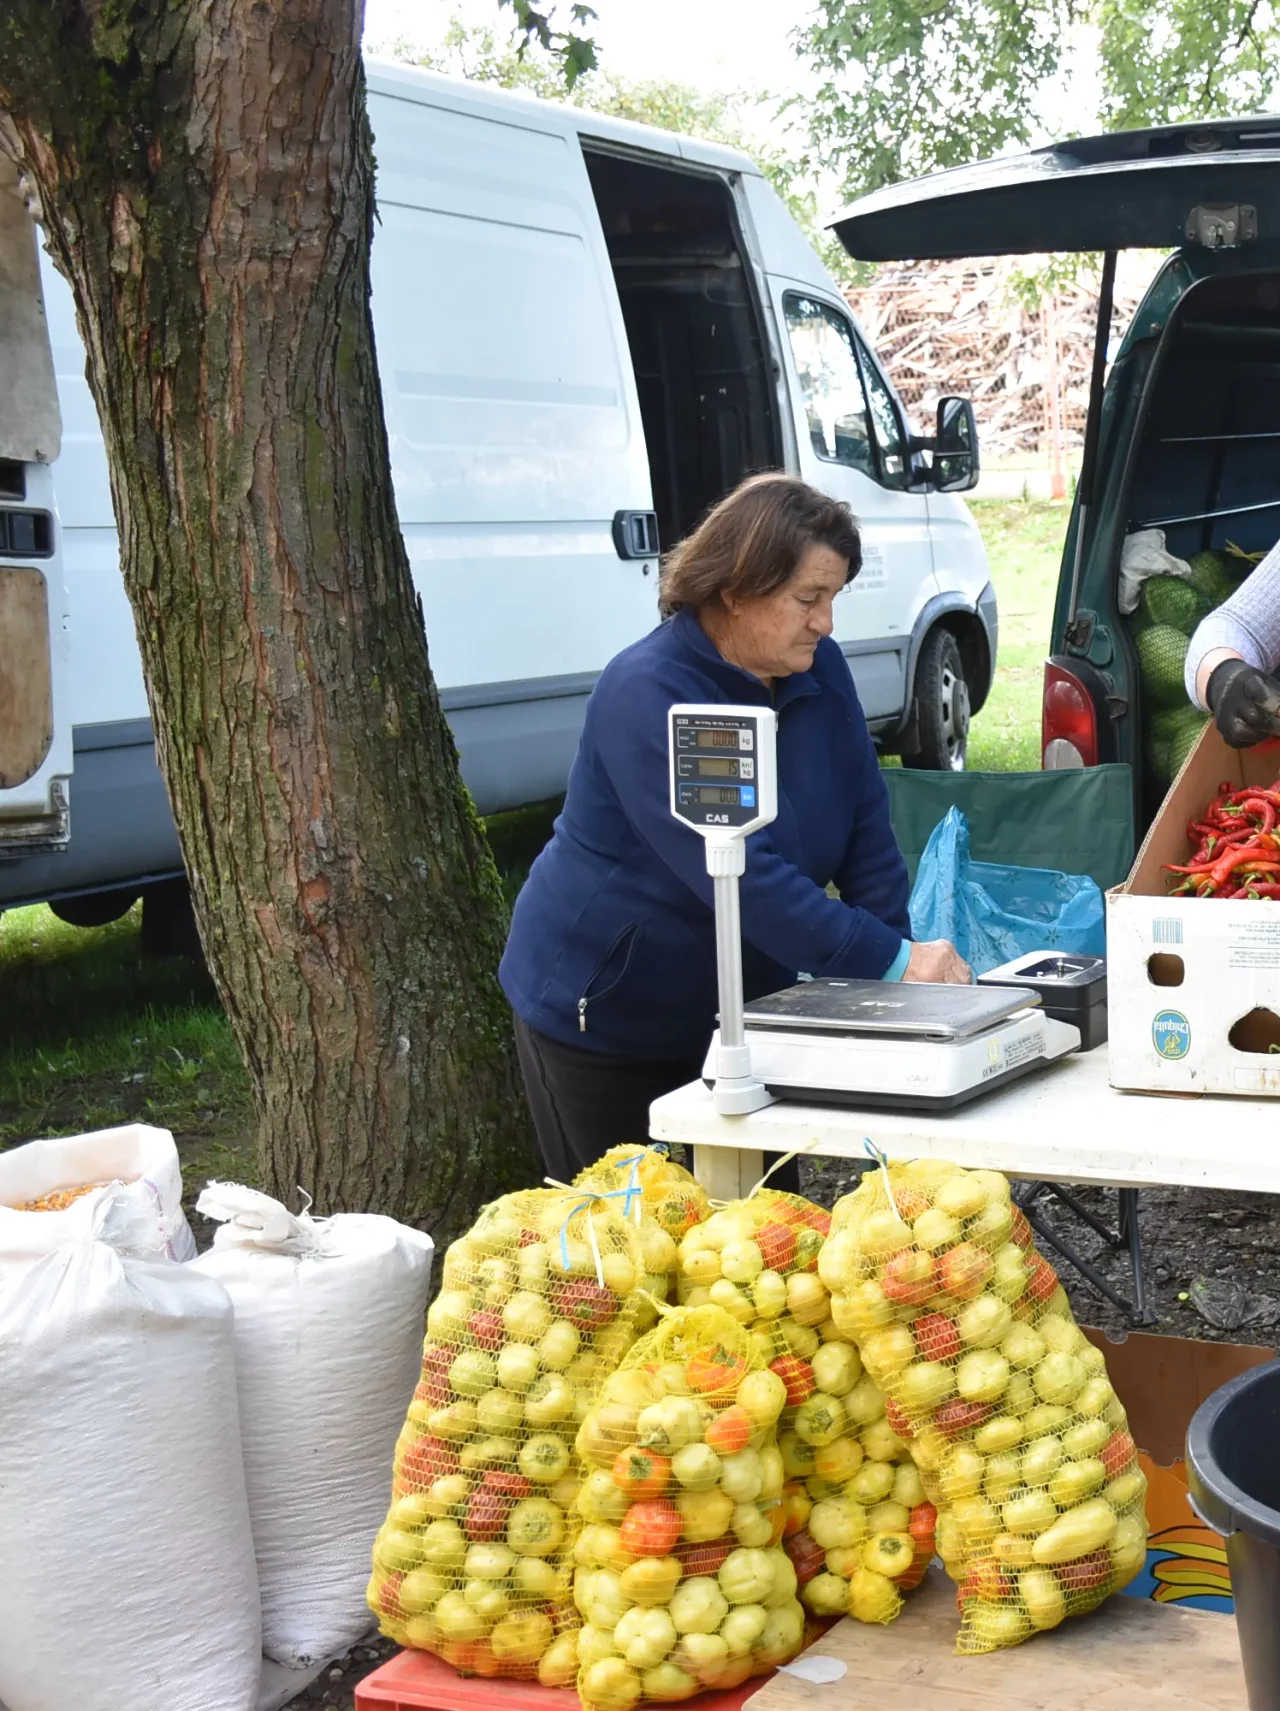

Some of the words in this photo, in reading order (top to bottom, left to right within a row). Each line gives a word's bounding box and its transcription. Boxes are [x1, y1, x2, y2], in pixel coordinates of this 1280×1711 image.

[742, 735, 750, 745] kg
[743, 769, 751, 777] kg
[706, 814, 729, 824] CAS
[1153, 1018, 1189, 1034] Chiquita
